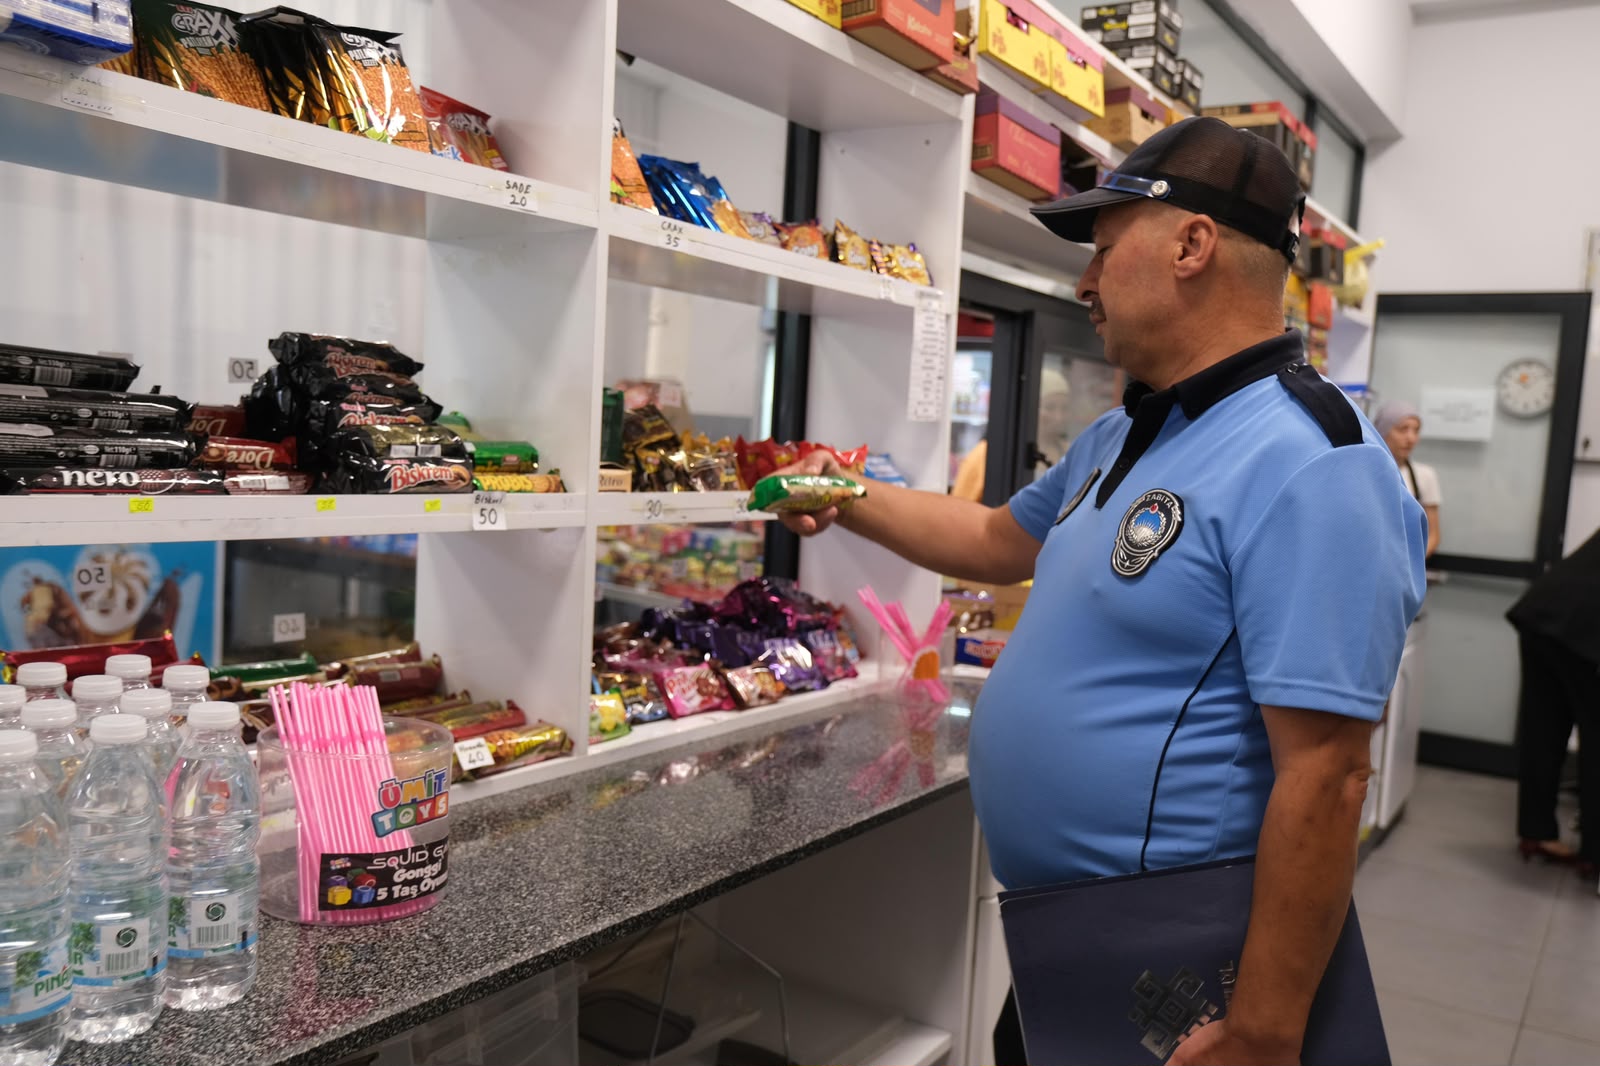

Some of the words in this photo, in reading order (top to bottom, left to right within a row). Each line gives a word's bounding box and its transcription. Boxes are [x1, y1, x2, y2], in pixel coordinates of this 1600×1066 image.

[505, 180, 532, 194] SADE
[509, 194, 527, 206] 20
[665, 233, 681, 248] 35
[225, 448, 275, 471] Dore
[60, 470, 140, 487] nero
[384, 463, 455, 493] Biskrem
[478, 507, 498, 525] 50
[645, 499, 663, 520] 30
[468, 750, 484, 765] 40
[377, 796, 448, 831] TOYS
[366, 847, 428, 870] SQUID
[393, 858, 442, 883] Gonggi
[376, 887, 389, 901] 5
[392, 884, 418, 898] Taş
